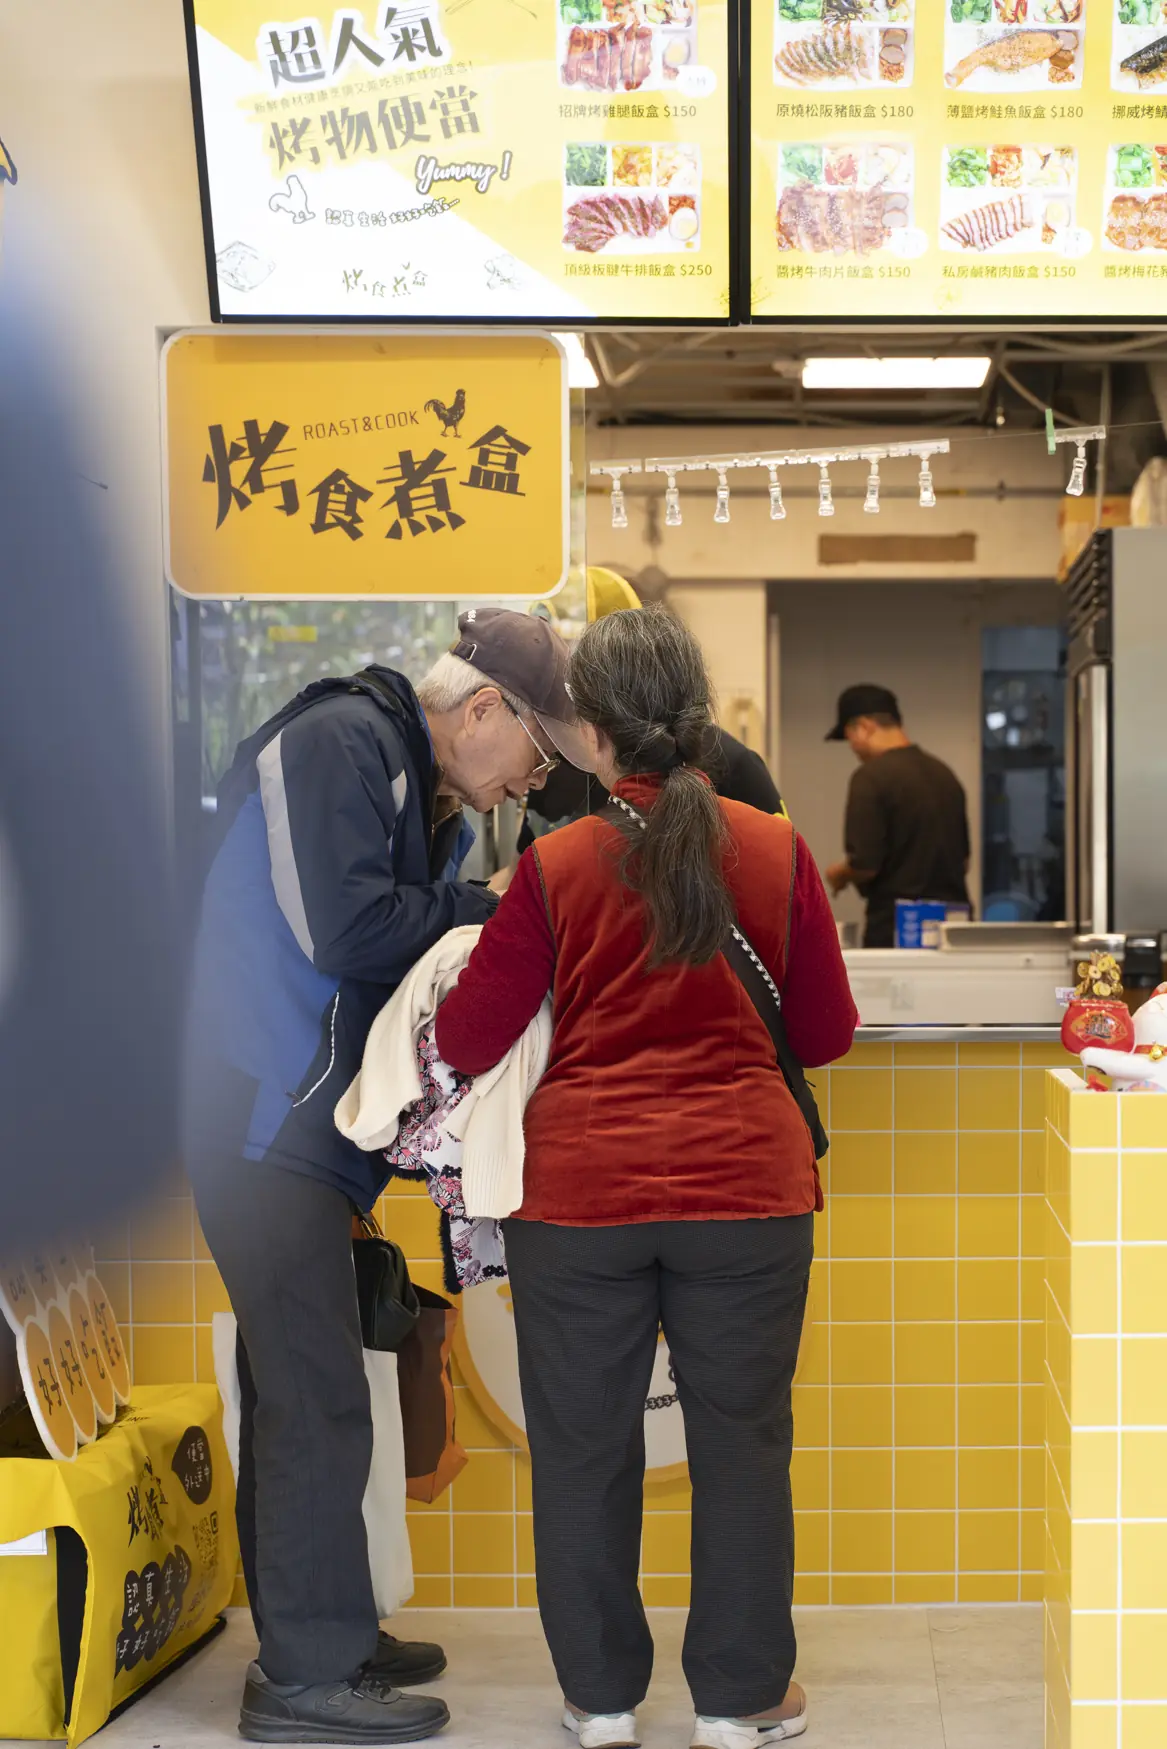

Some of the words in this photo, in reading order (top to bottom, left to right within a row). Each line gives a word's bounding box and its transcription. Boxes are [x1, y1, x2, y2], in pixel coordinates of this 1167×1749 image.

[264, 5, 443, 89] 超人氣
[559, 104, 660, 119] 招牌烤雞腿飯盒
[663, 104, 697, 118] $150
[775, 103, 877, 119] 原燒松阪豬飯盒
[880, 104, 914, 118] $180
[946, 103, 1047, 120] 薄鹽烤鮭魚飯盒
[1050, 104, 1084, 119] $180
[1111, 104, 1167, 120] 挪威烤鯖
[269, 84, 480, 171] 烤物便當
[563, 262, 677, 278] 頂級板腱牛排飯盒
[680, 264, 713, 278] $250
[775, 264, 875, 279] 醬烤牛肉片飯盒
[878, 265, 912, 279] $150
[941, 264, 1040, 279] 私房鹹豬肉飯盒
[1043, 265, 1077, 279] $150
[302, 410, 420, 441] ROAST&COOK
[201, 418, 532, 541] 烤食煮盒
